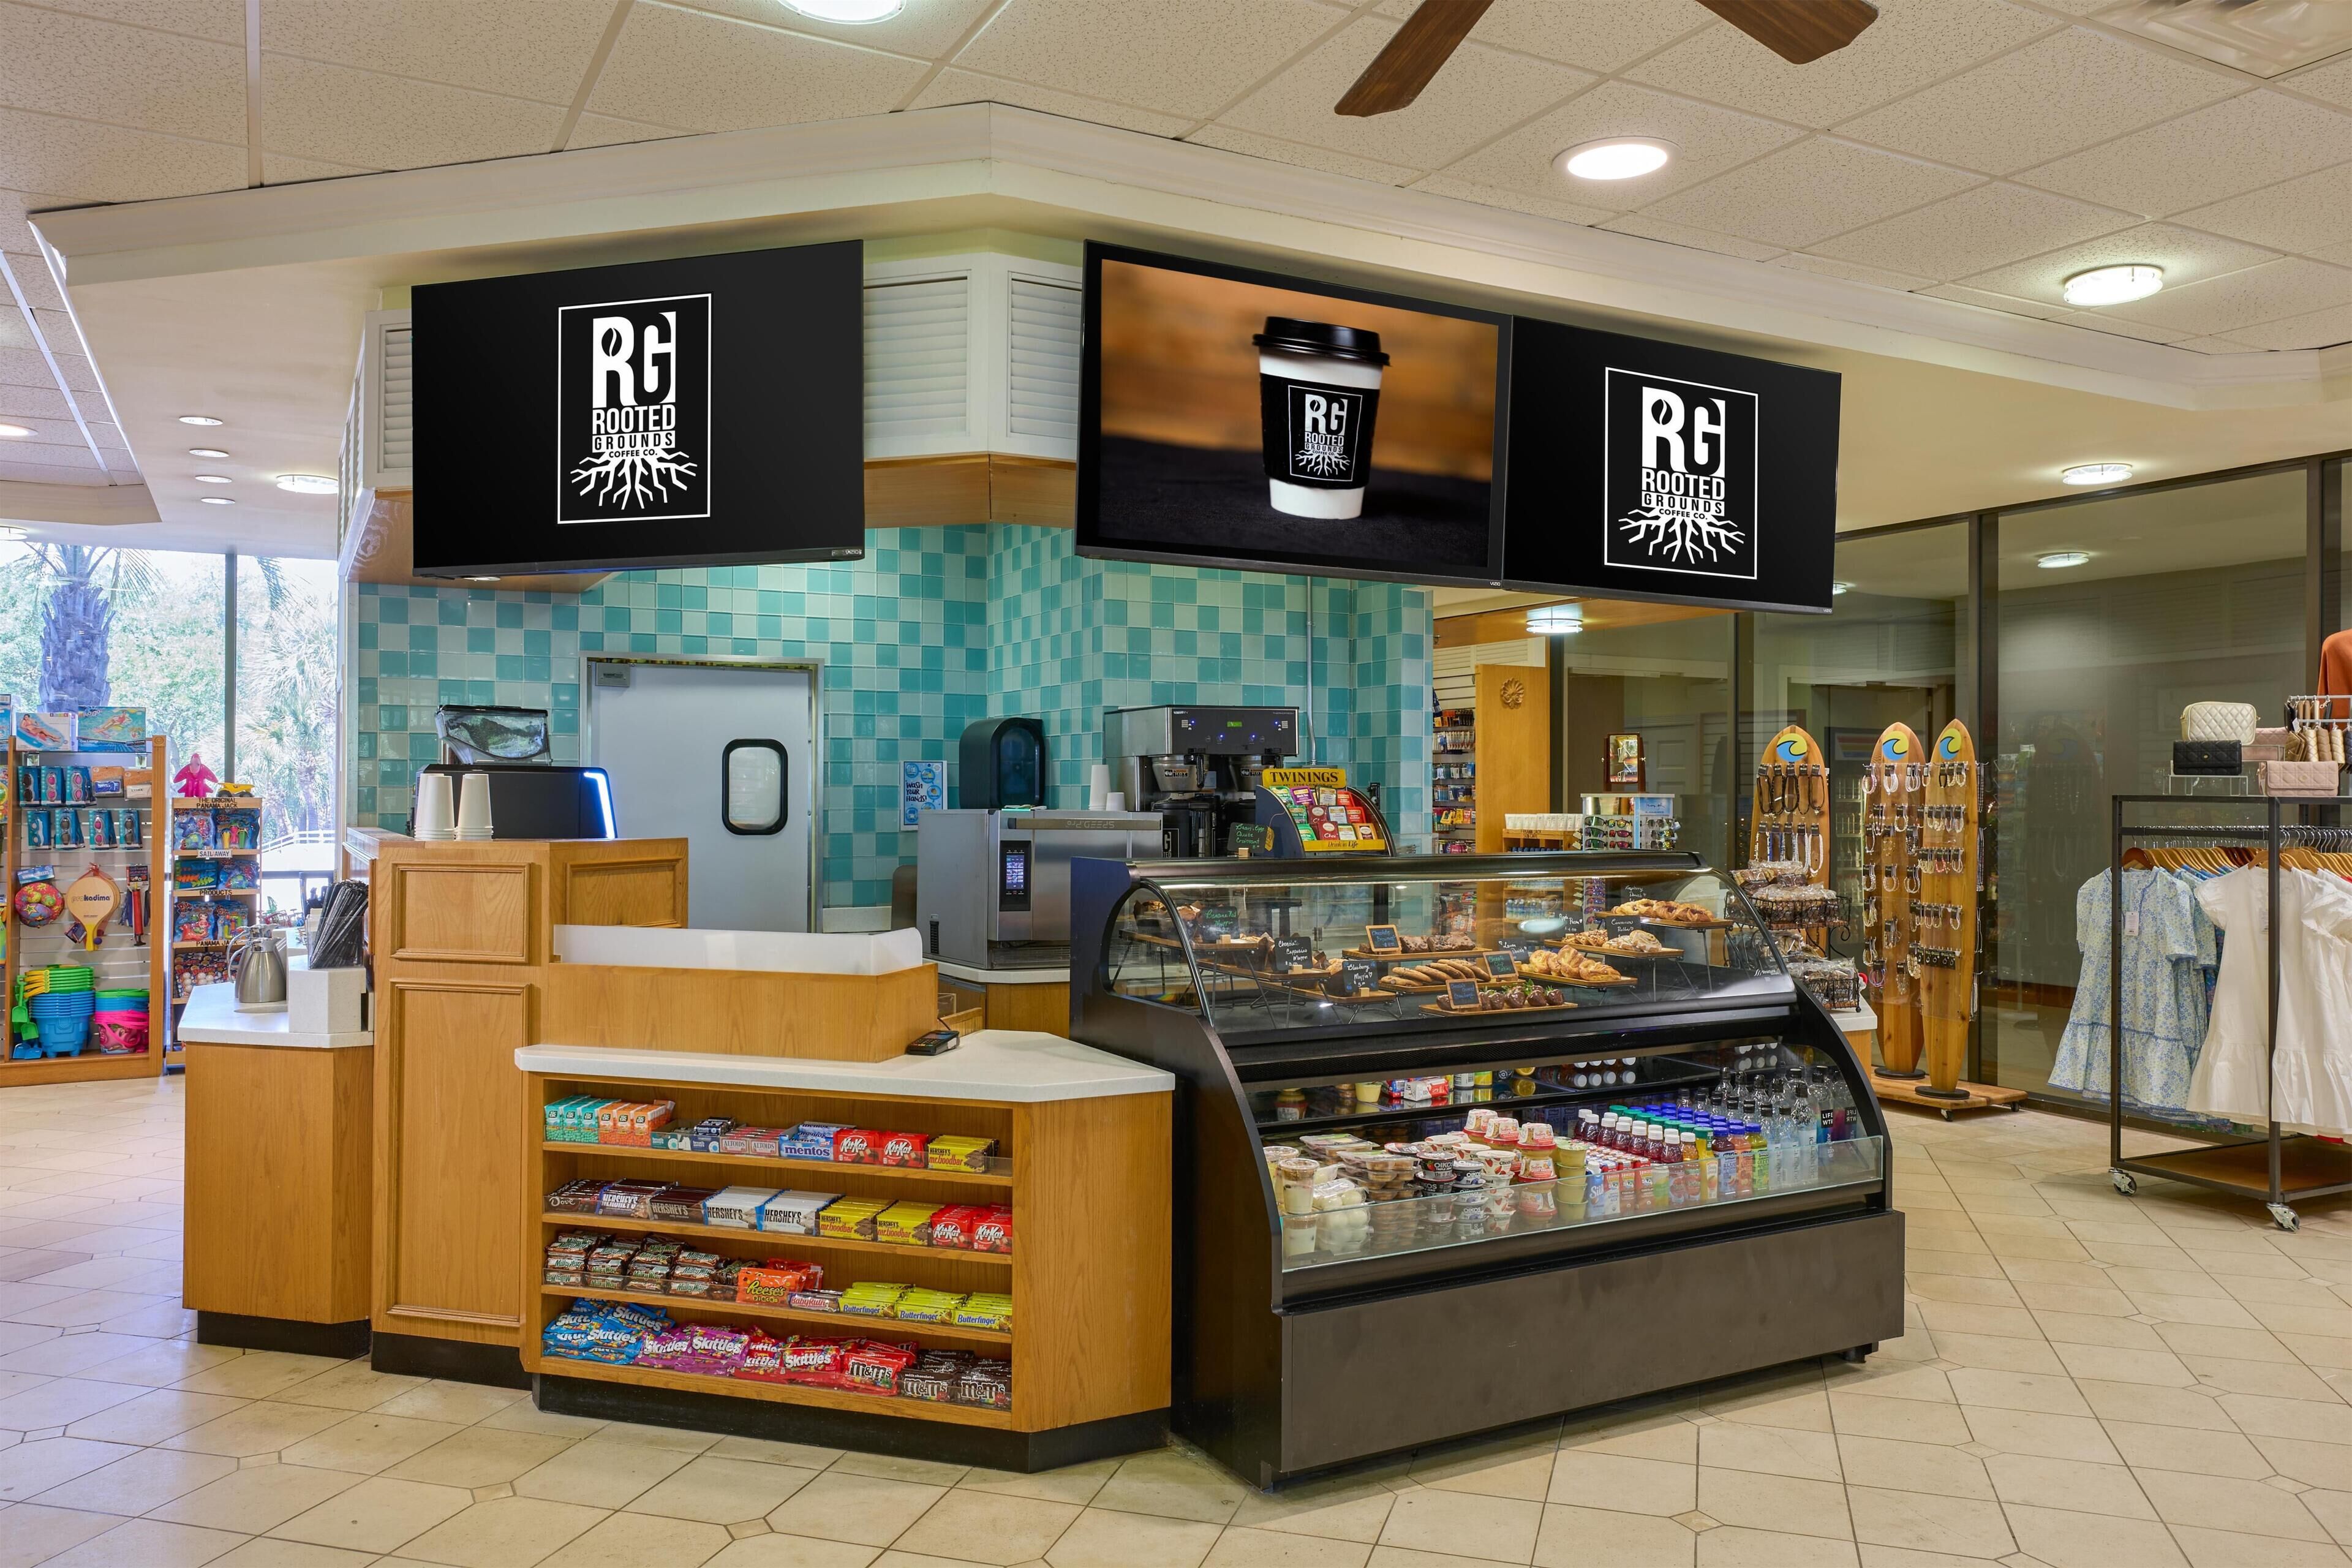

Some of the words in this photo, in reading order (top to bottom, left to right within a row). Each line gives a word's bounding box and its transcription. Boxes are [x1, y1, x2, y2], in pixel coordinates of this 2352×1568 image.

[593, 311, 676, 408] RG
[593, 405, 676, 434] ROOTED
[1305, 394, 1348, 435] RG
[1305, 431, 1344, 446] ROOTED
[1642, 386, 1725, 478] RG
[594, 432, 673, 450] GROUNDS
[1305, 443, 1343, 453] GROUNDS
[609, 449, 639, 458] COFFEE
[1642, 468, 1725, 500] ROOTED
[1645, 494, 1722, 513] GROUNDS
[1659, 508, 1690, 518] COFFEE
[1270, 772, 1338, 782] TWININGS
[1163, 832, 1171, 852] G
[1348, 963, 1370, 973] Blueberry
[785, 1147, 830, 1156] mentos
[601, 1194, 638, 1208] HERSHEY'S
[652, 1202, 688, 1216] HERSHEY'S
[707, 1207, 743, 1220] HERSHEY'S
[764, 1208, 802, 1223] HERSHEY'S
[843, 1304, 880, 1314] Butterfinger
[900, 1311, 938, 1321] Butterfinger
[613, 1305, 663, 1332] Skittles
[957, 1314, 997, 1325] Butterfinger
[587, 1330, 637, 1344] Skittles
[644, 1340, 688, 1354] Skittles
[692, 1337, 742, 1355] Skittles
[785, 1354, 832, 1368] Skittles
[850, 1361, 892, 1378] m&m's
